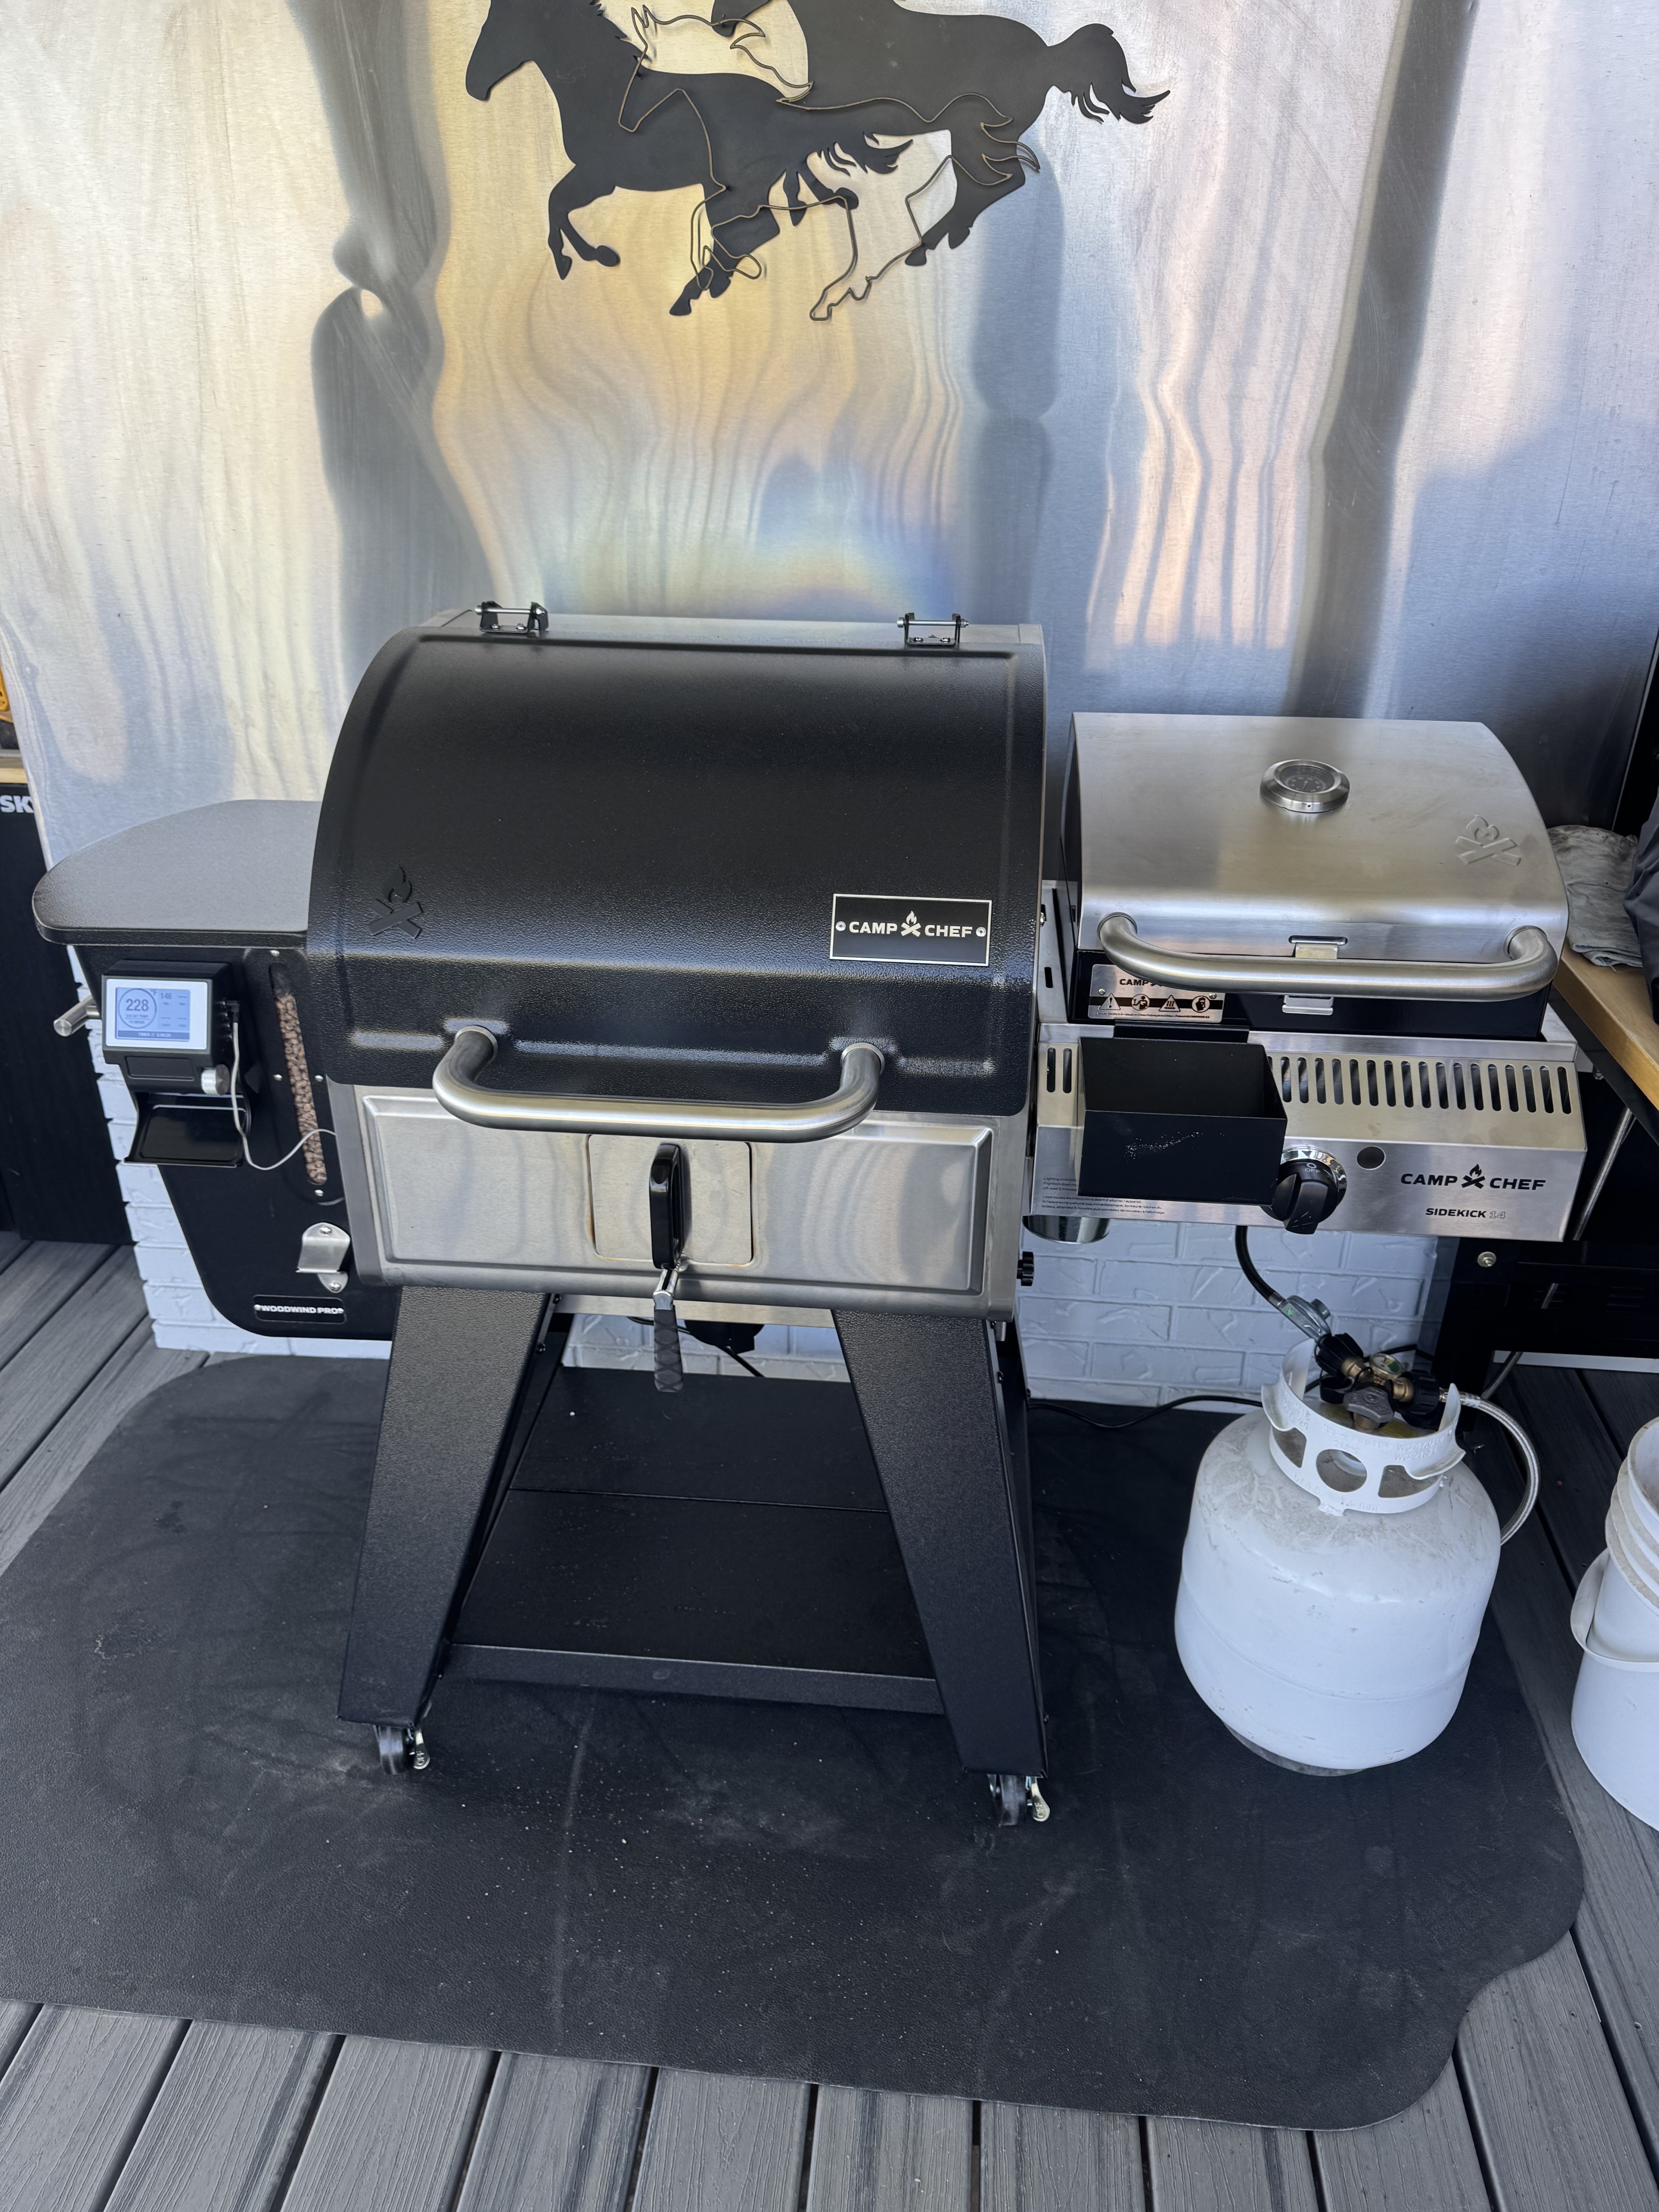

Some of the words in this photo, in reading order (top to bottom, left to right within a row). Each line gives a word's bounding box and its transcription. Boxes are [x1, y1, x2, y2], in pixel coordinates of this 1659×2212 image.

[849, 921, 898, 934] CAMP
[925, 925, 973, 937] CHEF
[126, 998, 149, 1011] 228
[1401, 1173, 1458, 1186] CAMP
[1490, 1178, 1546, 1190] CHEF
[1425, 1208, 1487, 1218] SIDEKICK
[261, 1305, 316, 1313] WOODWIND
[1034, 1802, 1045, 1818] OFF
